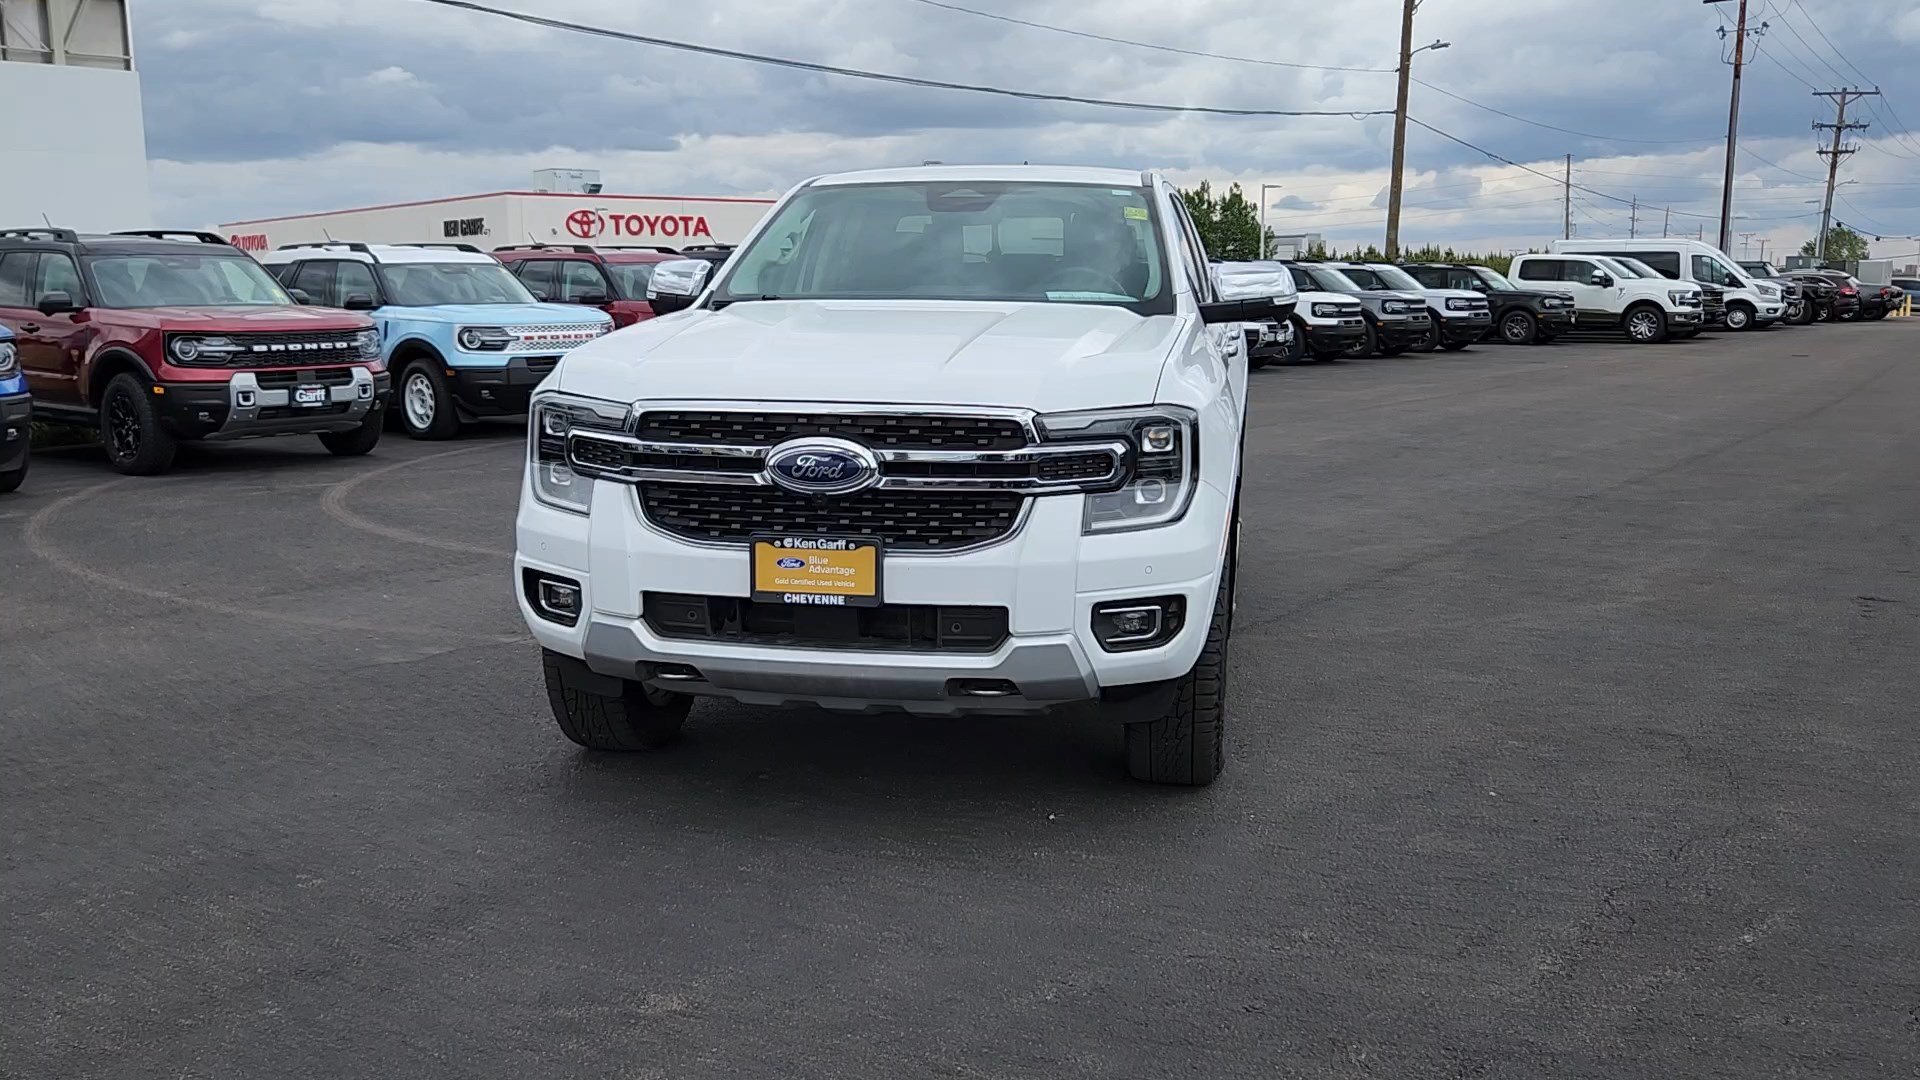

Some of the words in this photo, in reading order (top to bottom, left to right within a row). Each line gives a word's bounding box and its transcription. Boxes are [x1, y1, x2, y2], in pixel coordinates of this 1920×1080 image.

[609, 214, 711, 237] TOYOTA
[252, 342, 348, 352] BRONCO
[295, 389, 326, 402] Garff
[791, 454, 845, 479] Ford
[794, 538, 817, 549] Ken
[817, 539, 847, 551] Garff
[780, 559, 801, 568] Ford
[808, 556, 829, 565] Blue
[808, 565, 856, 576] Advantage
[774, 577, 790, 585] Gold
[790, 578, 816, 586] Certified
[833, 580, 856, 588] Vehicle
[783, 593, 846, 606] CHEYENNE
